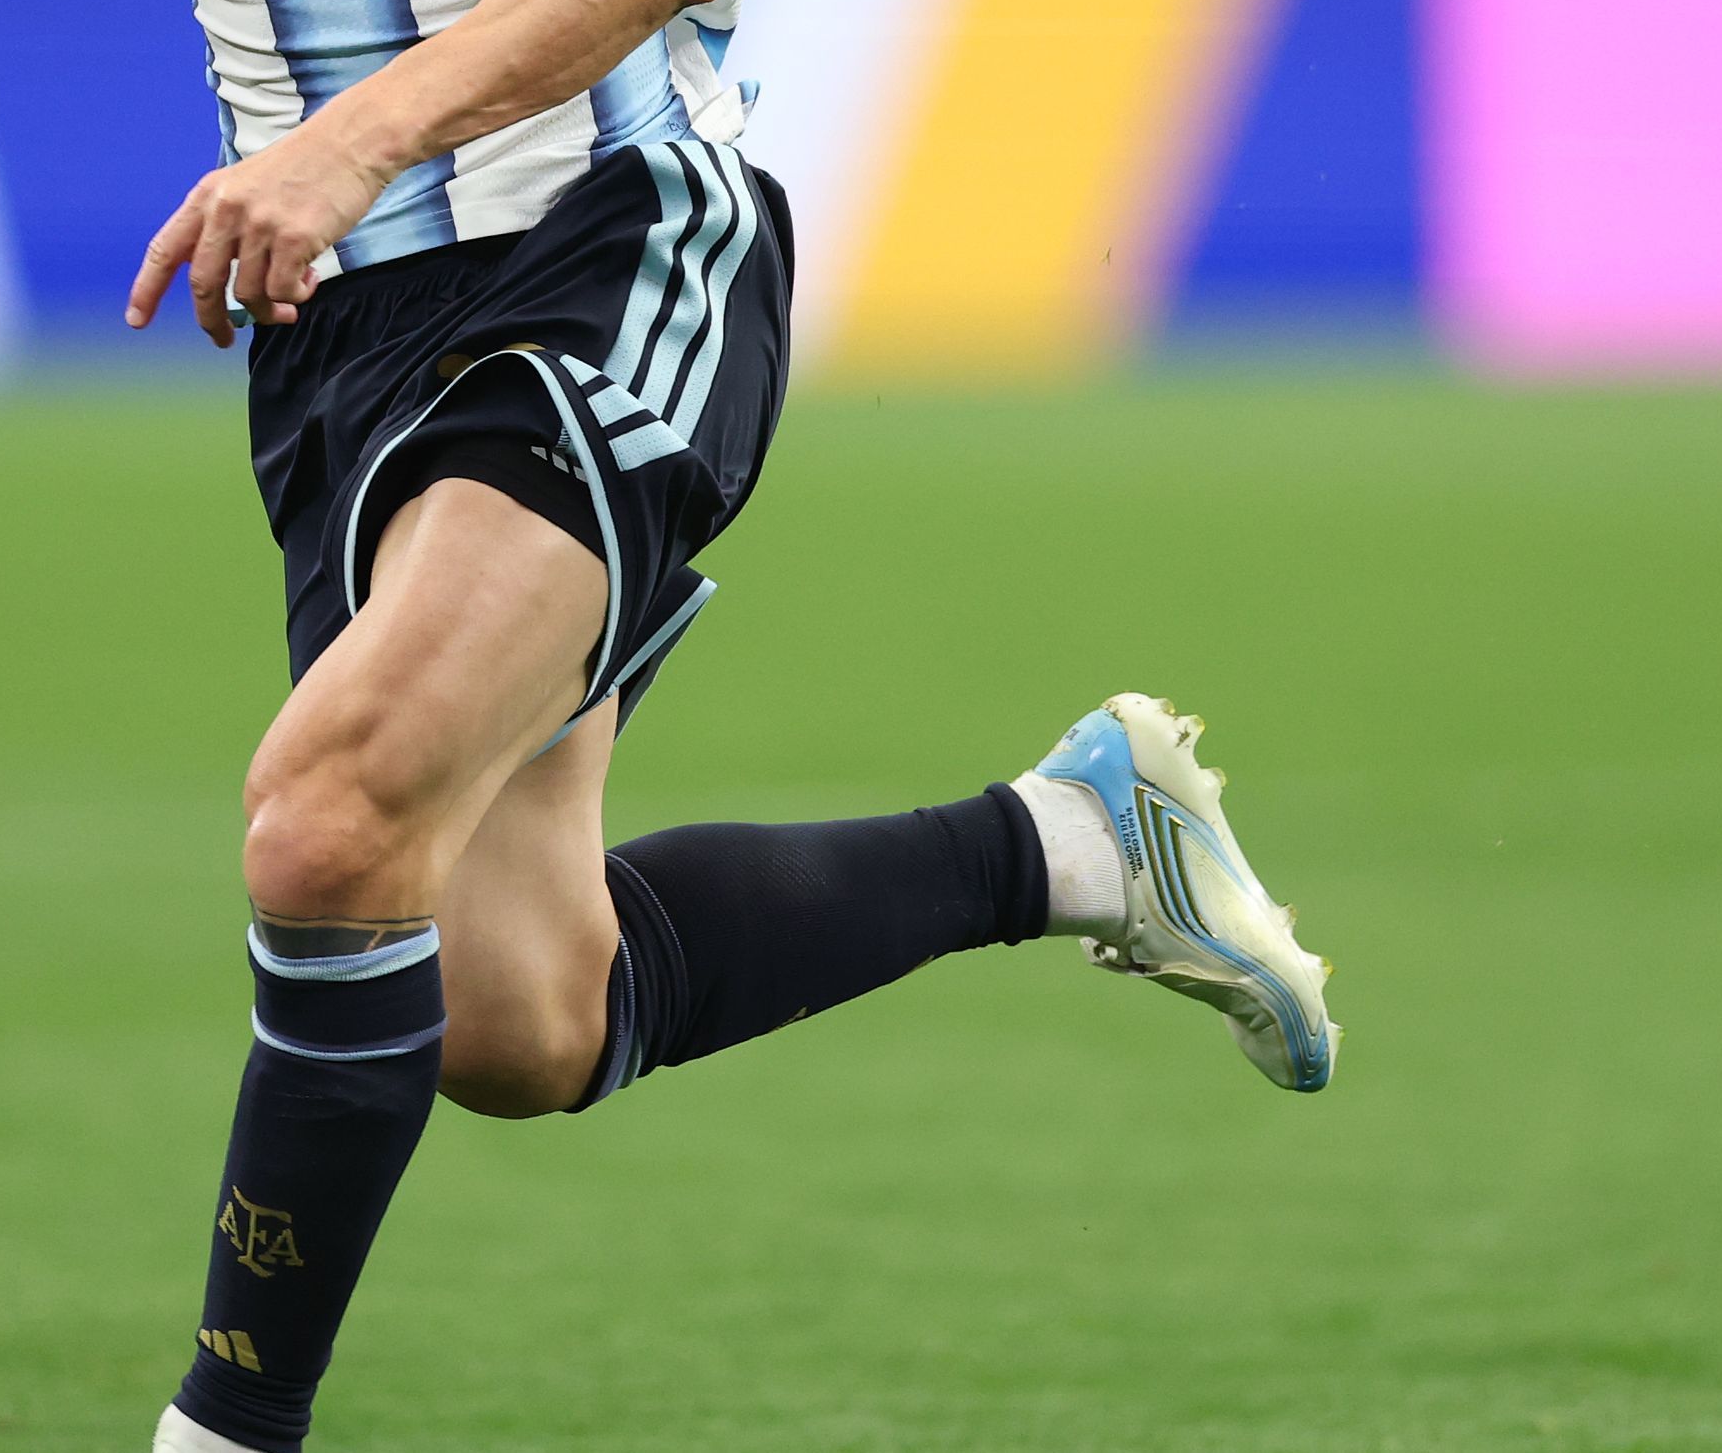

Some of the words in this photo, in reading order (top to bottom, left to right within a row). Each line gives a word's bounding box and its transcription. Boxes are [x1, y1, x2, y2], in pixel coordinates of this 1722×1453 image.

[1124, 844, 1139, 880] THIAGO
[1132, 837, 1144, 870] MATEO
[219, 1185, 304, 1278] AFA
